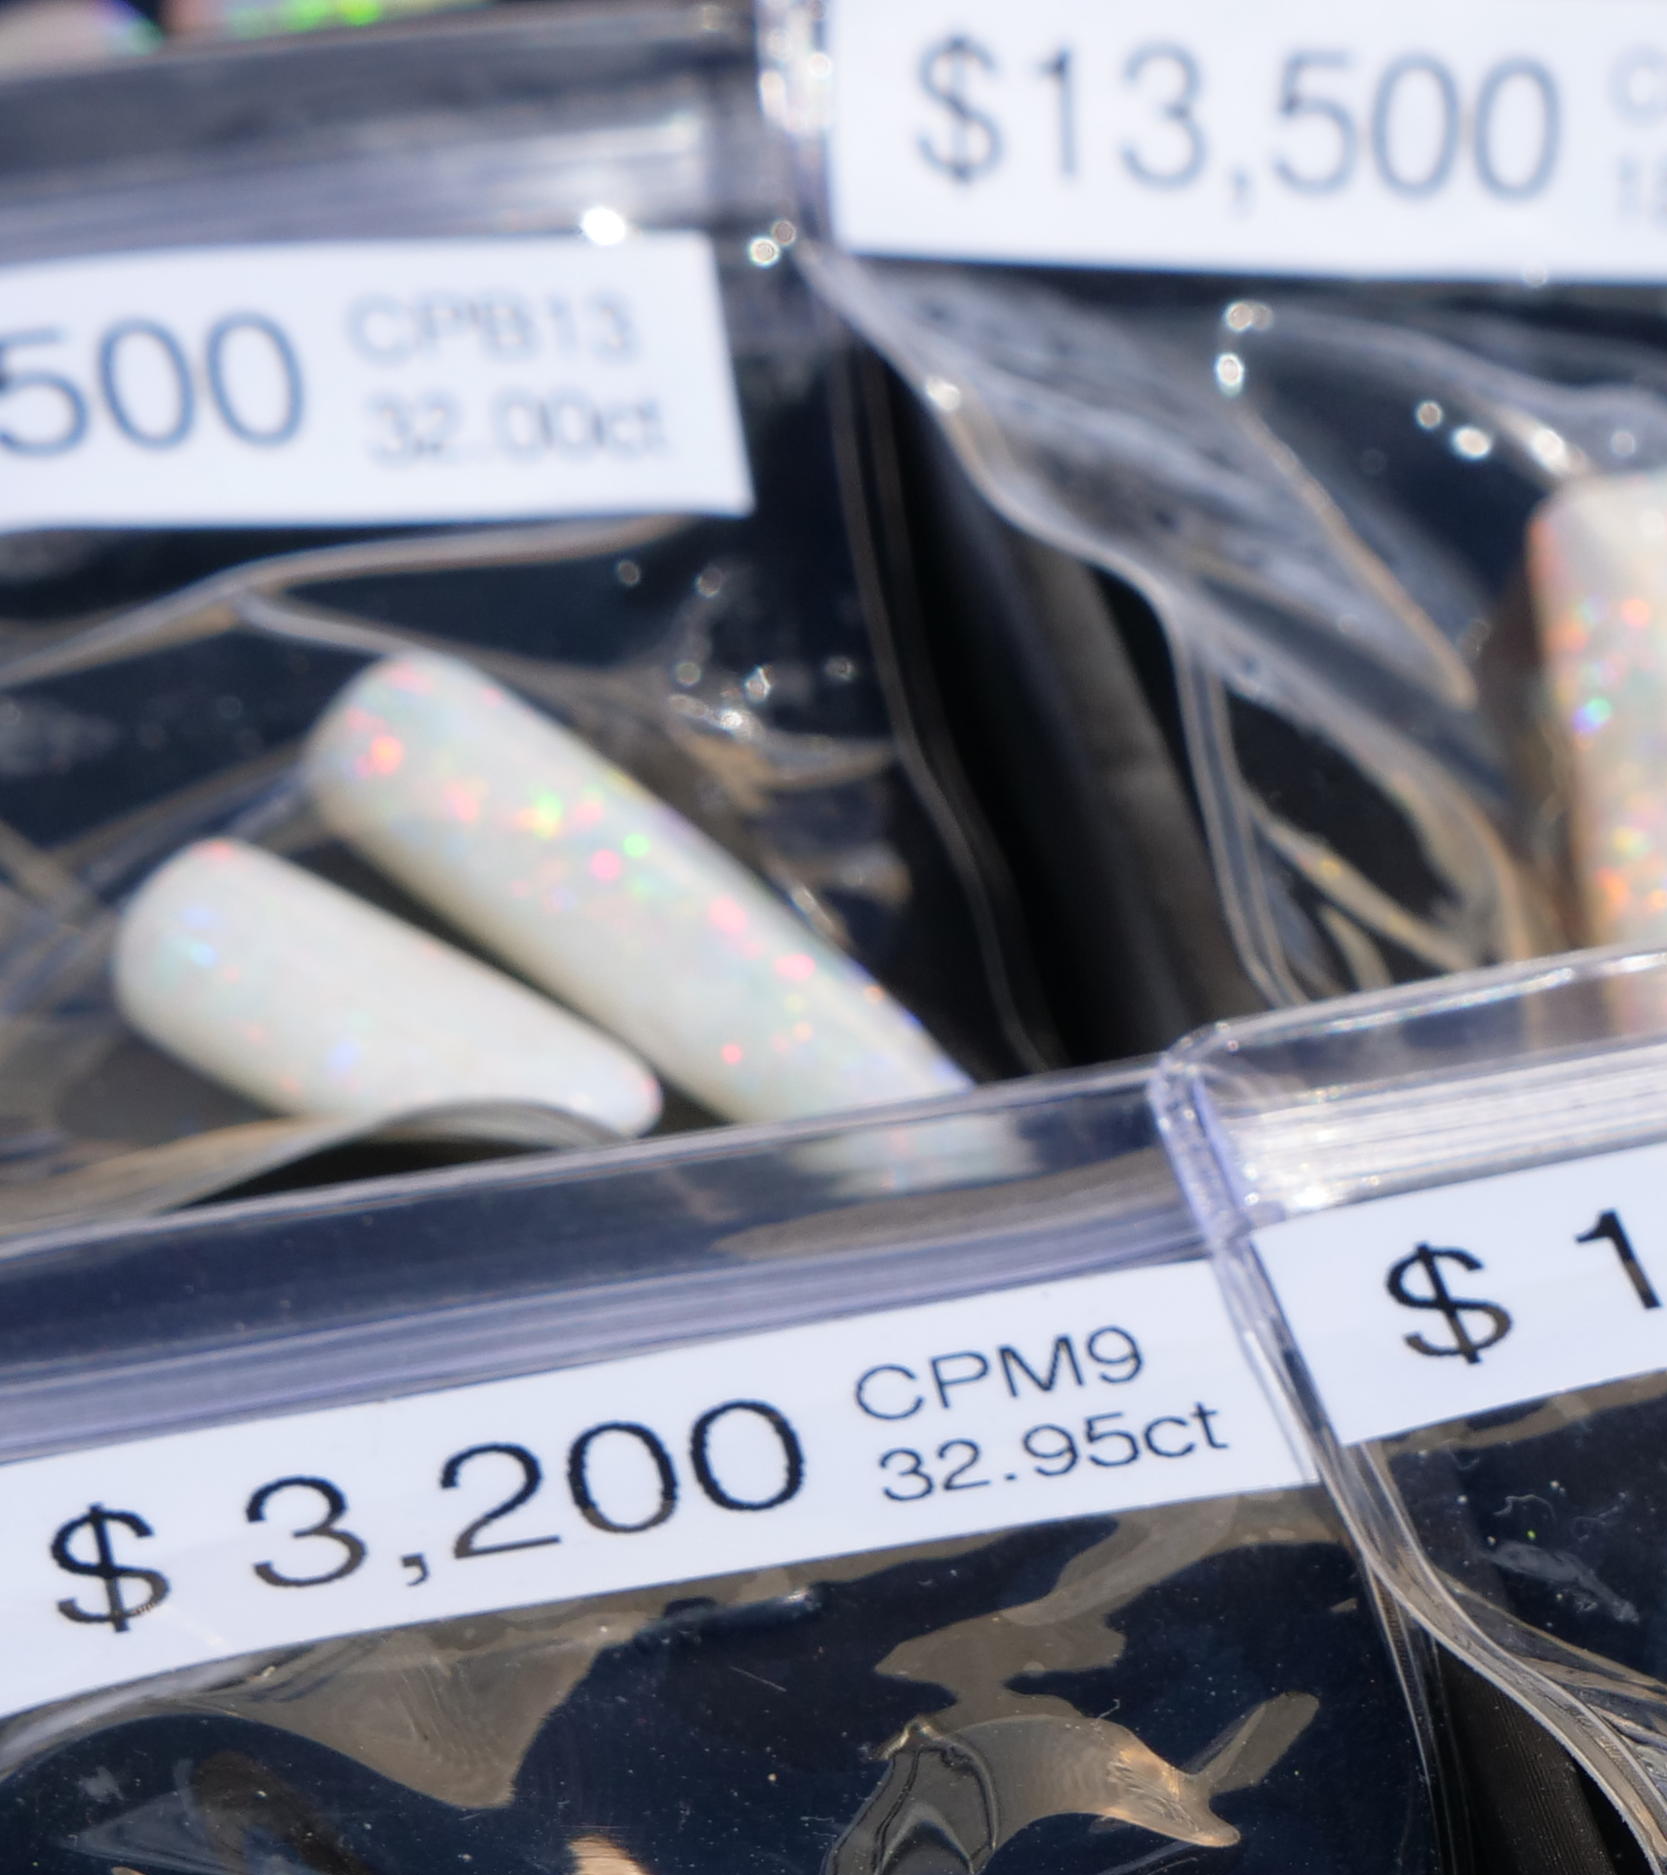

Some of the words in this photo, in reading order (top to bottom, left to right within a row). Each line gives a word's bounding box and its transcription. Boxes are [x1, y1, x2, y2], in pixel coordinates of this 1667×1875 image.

[913, 28, 1565, 218] $13,500
[342, 286, 644, 368] CPB13
[1383, 1240, 1515, 1367] $
[852, 1324, 1146, 1424] CPM9
[876, 1398, 1231, 1504] 32.95ct
[47, 1501, 173, 1635] $
[242, 1397, 808, 1590] 3,200
